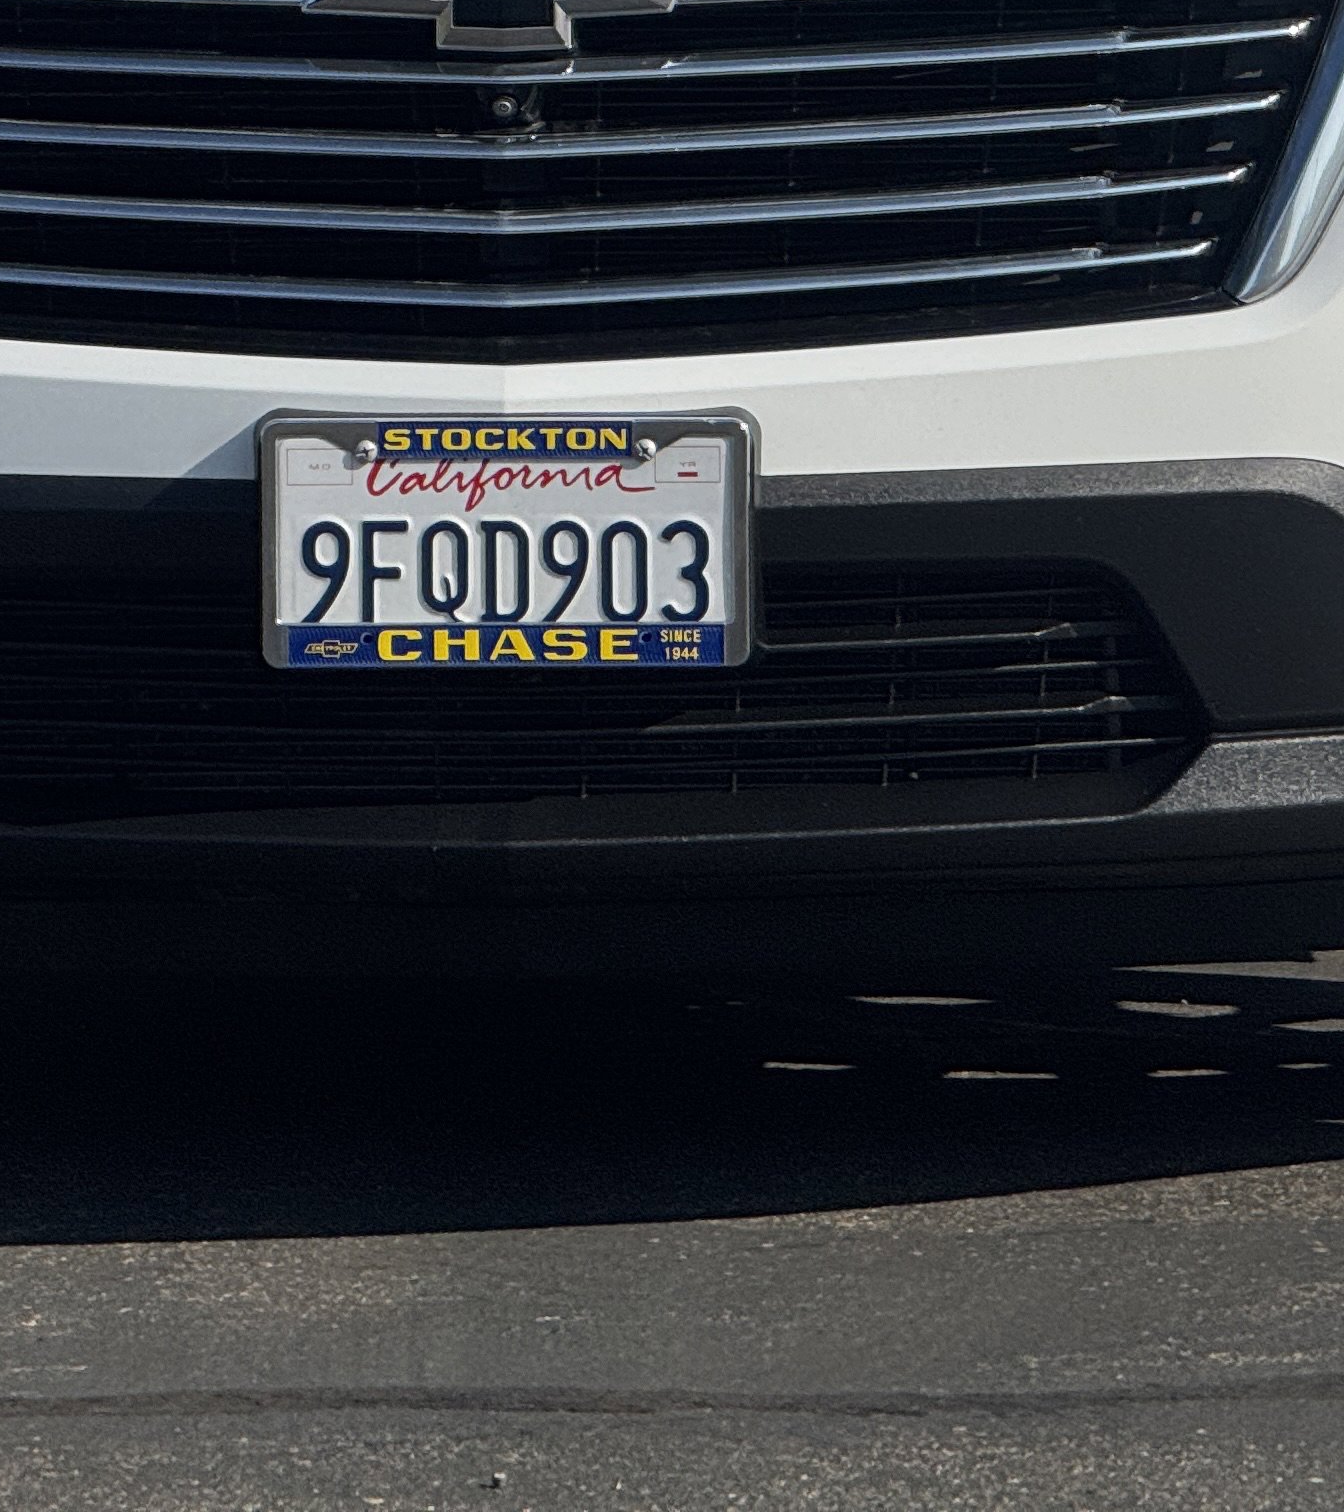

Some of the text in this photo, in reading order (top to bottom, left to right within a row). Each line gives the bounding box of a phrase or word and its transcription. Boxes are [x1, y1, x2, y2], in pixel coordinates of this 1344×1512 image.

[383, 428, 627, 451] STOCKTON
[366, 459, 655, 512] California
[301, 520, 710, 623] 9FQD903
[377, 628, 639, 661] CHASE
[660, 629, 701, 642] SINCE
[664, 646, 699, 660] 1944
